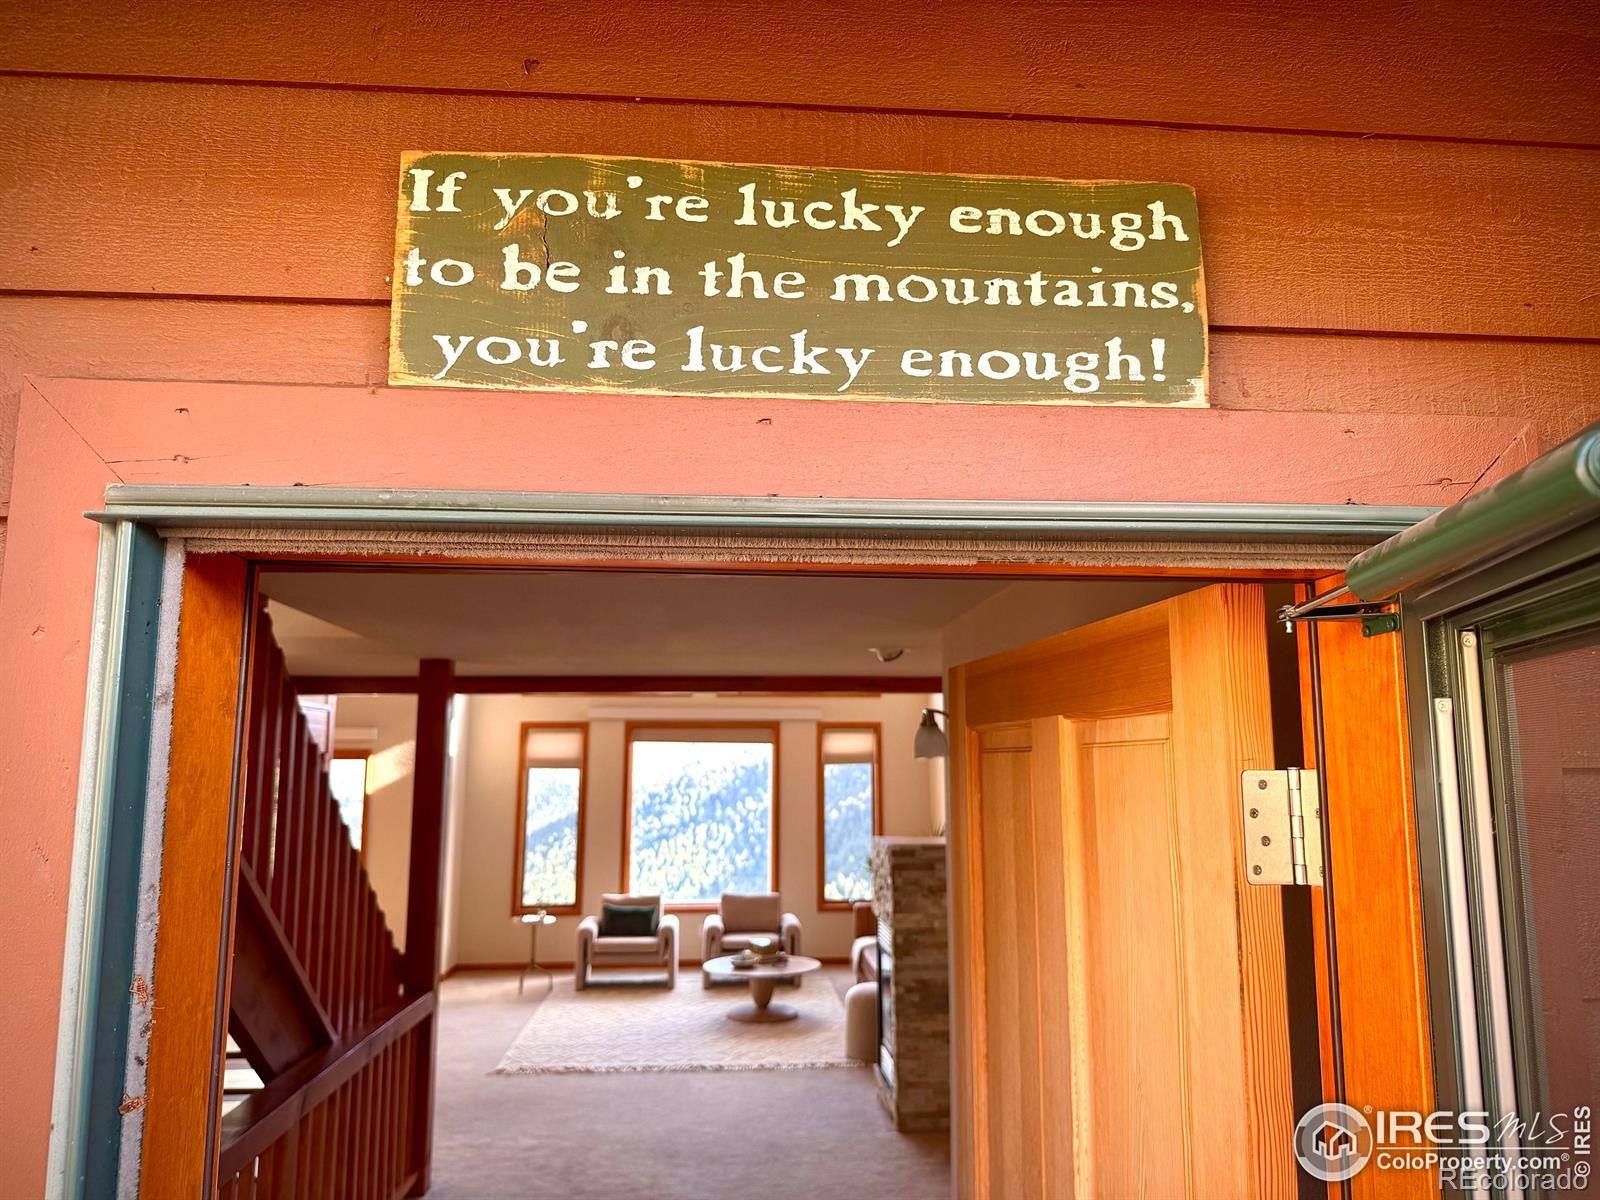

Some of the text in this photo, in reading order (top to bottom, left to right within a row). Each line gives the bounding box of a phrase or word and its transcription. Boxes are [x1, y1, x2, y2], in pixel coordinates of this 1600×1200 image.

[408, 168, 1190, 252] If you're lucky enough
[402, 243, 1195, 313] to be in the mountains,
[431, 319, 1166, 394] you're lucky enough!
